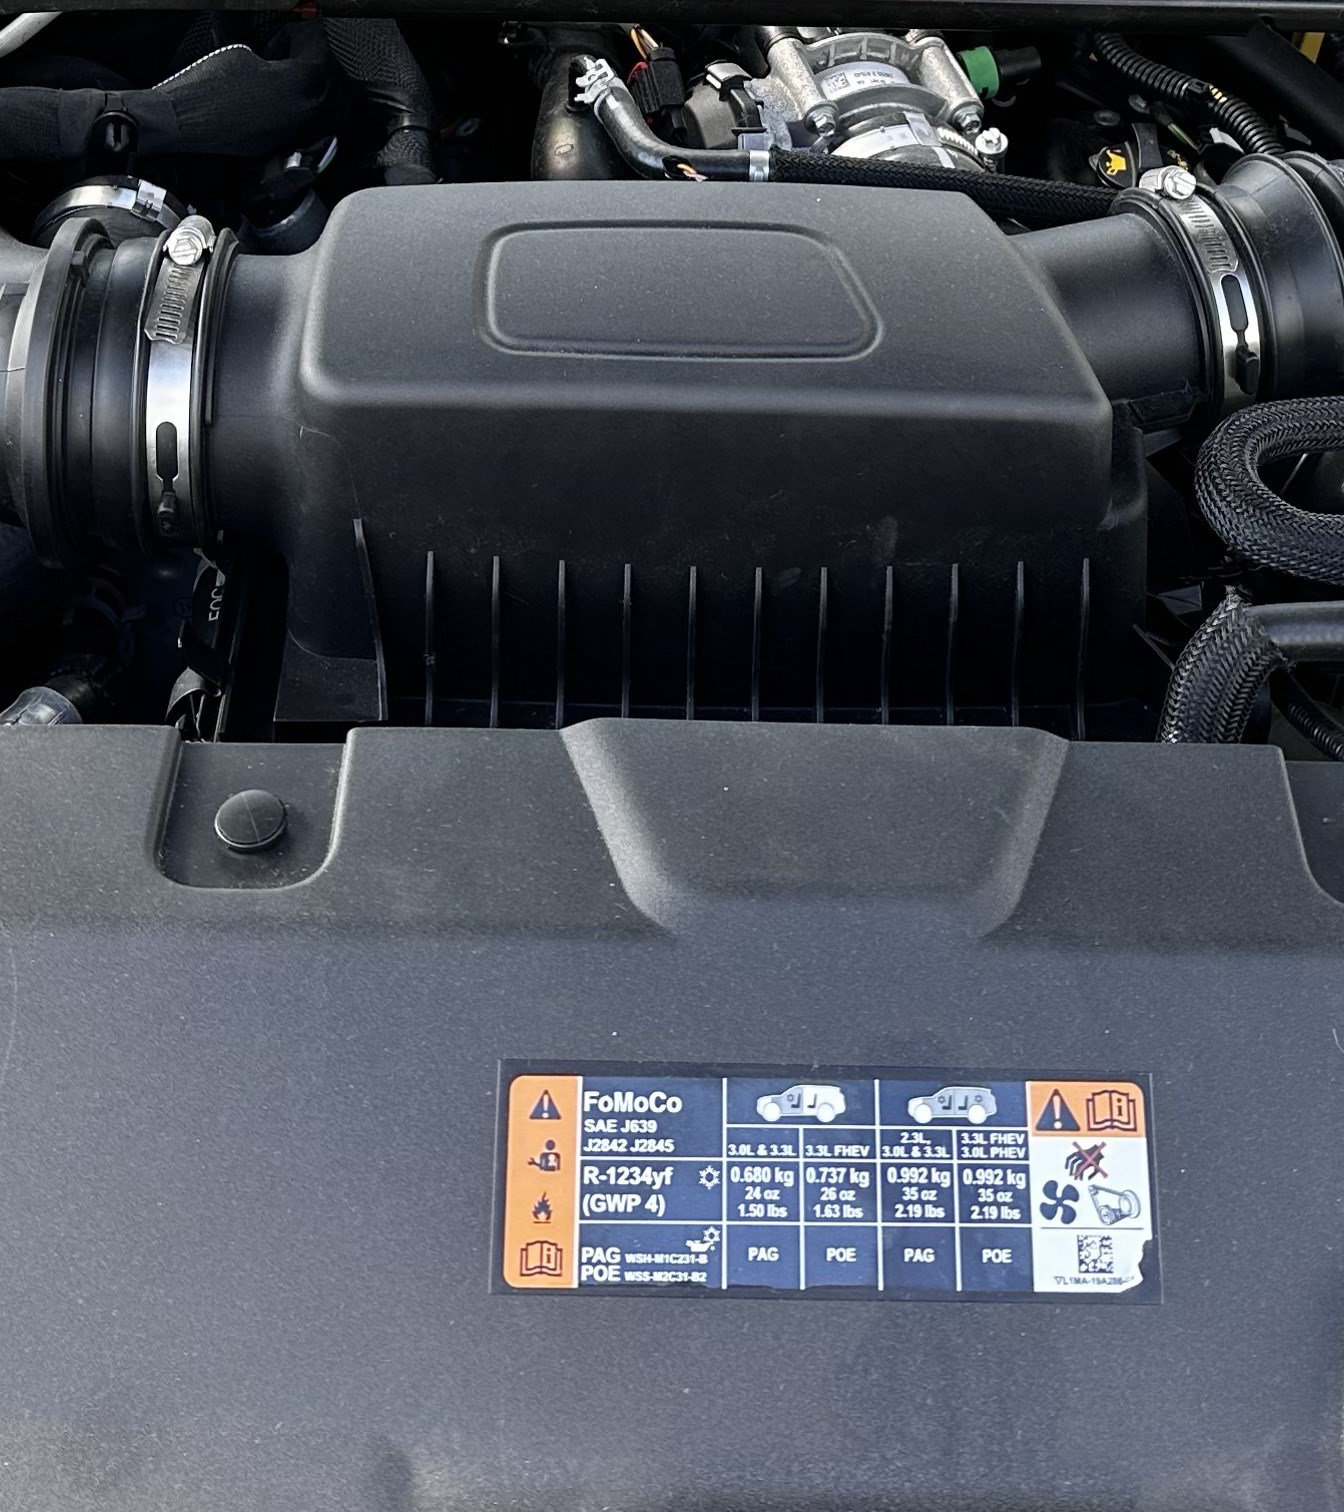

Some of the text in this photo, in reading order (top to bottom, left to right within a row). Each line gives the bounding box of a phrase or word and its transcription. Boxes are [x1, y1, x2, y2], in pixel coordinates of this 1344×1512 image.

[583, 1090, 683, 1113] FoMoCo
[583, 1118, 658, 1133] SAE J639
[583, 1138, 675, 1153] J2842 J2845
[899, 1131, 932, 1145] 2.3L,
[960, 1132, 1026, 1145] 3.3L FHEV
[727, 1143, 797, 1156] 3.0L & 3.3L
[804, 1144, 870, 1157] 3.3L FHEV
[881, 1145, 951, 1158] 3.0L & 3.3L
[960, 1146, 1027, 1159] 3.0L PHEV
[583, 1165, 674, 1190] R-1234yf
[730, 1166, 794, 1187] 0.680 kg
[805, 1167, 870, 1188] 0.737 kg
[886, 1166, 951, 1188] 0.992 kg
[962, 1168, 1027, 1190] 0.992 kg
[744, 1186, 780, 1201] 24 oz
[819, 1186, 856, 1201] 26 oz
[902, 1186, 938, 1201] 35 oz
[977, 1188, 1013, 1203] 35 oz
[582, 1193, 666, 1217] (GWP 4)
[737, 1203, 788, 1218] 1.50 lbs
[813, 1203, 864, 1219] 1.63 lbs
[894, 1203, 945, 1218] 2.19 lbs
[970, 1205, 1021, 1220] 2.19 lbs
[581, 1246, 621, 1264] PAG
[747, 1247, 779, 1261] PAG
[826, 1247, 857, 1262] POE
[903, 1248, 935, 1263] PAG
[981, 1249, 1012, 1263] POE
[581, 1265, 621, 1281] POE
